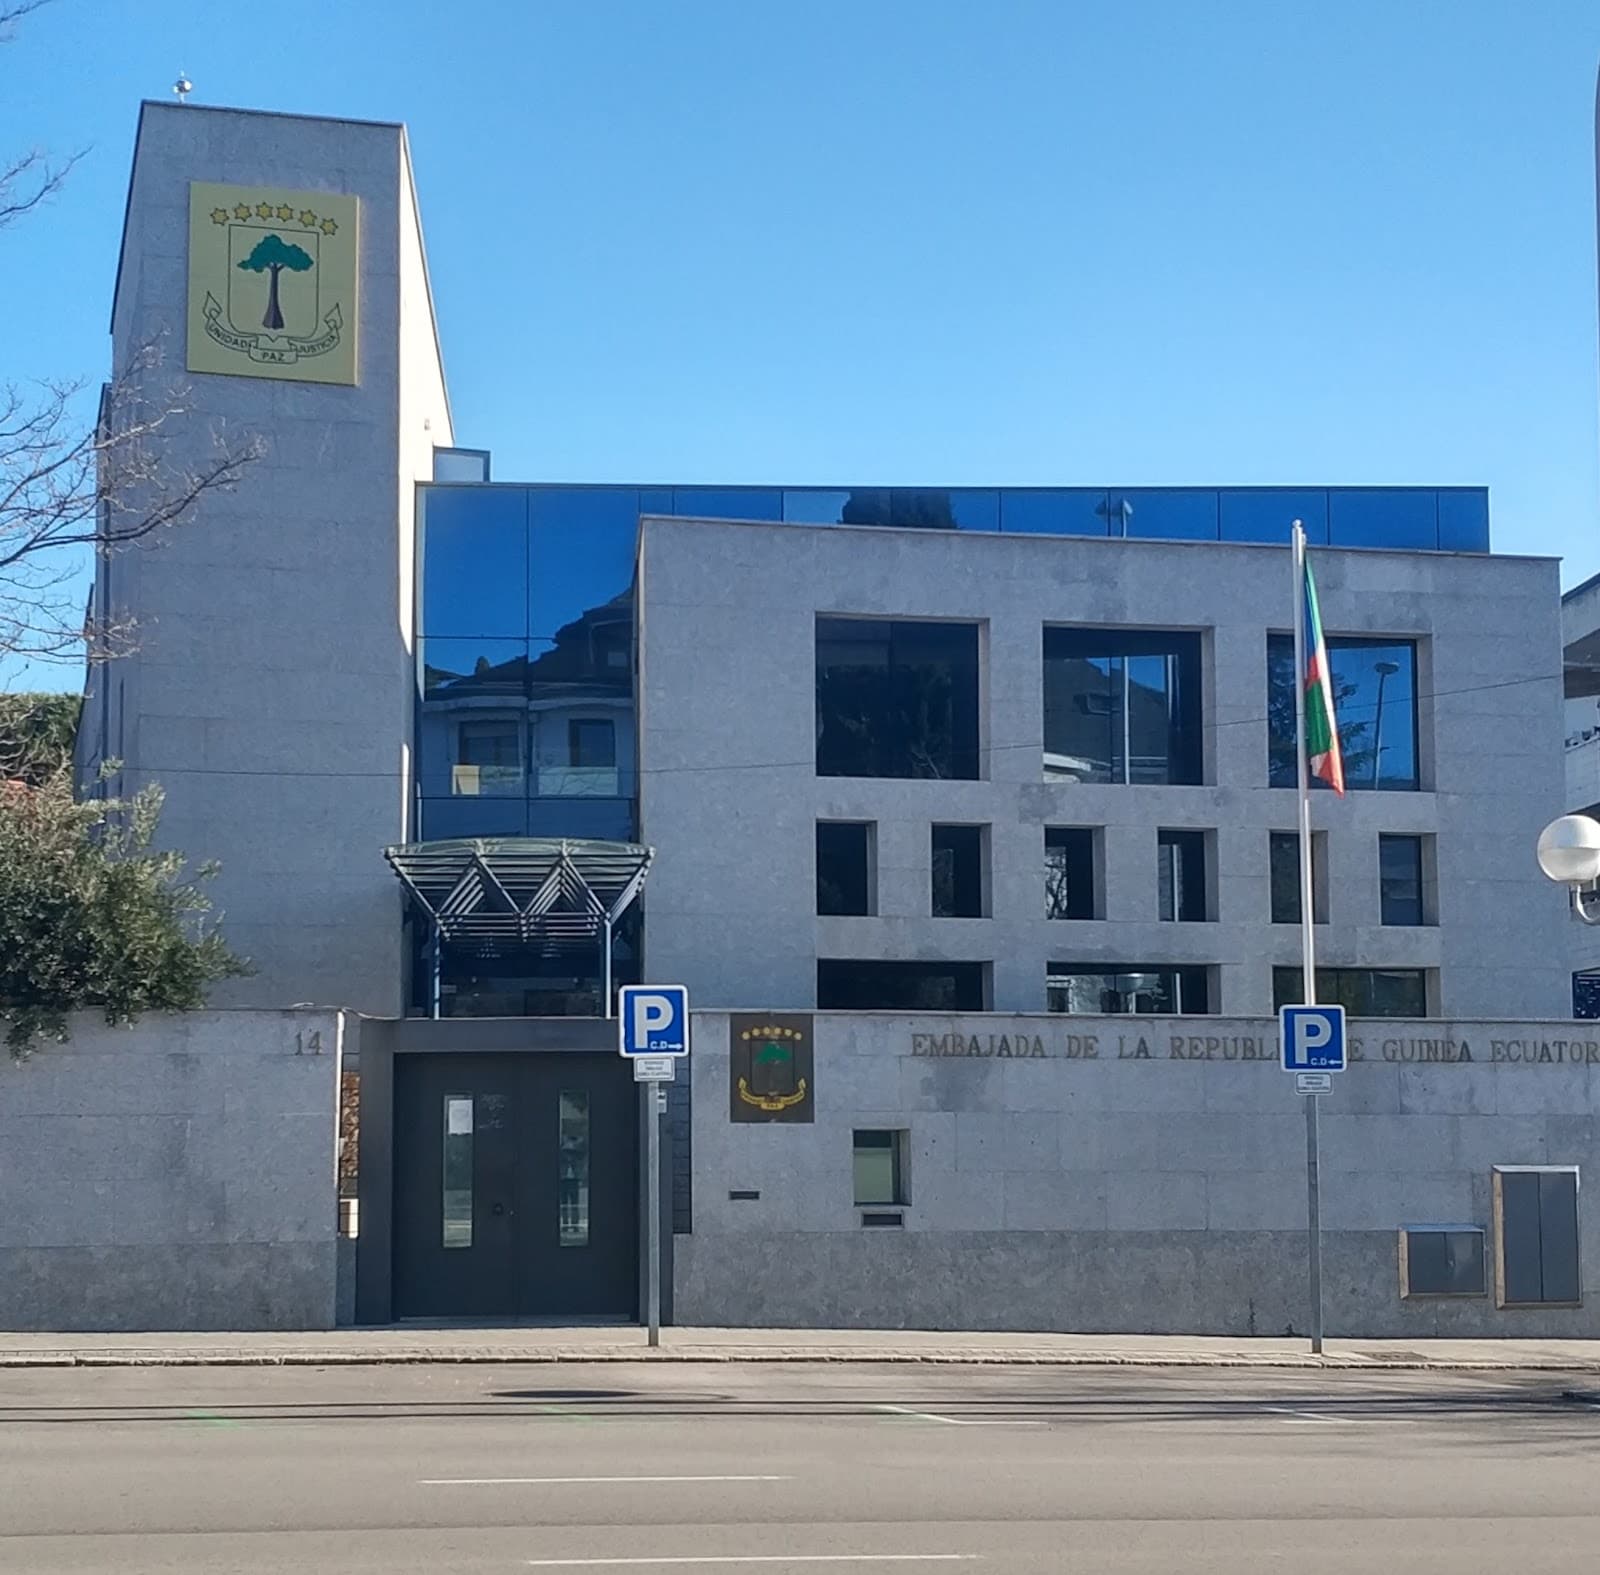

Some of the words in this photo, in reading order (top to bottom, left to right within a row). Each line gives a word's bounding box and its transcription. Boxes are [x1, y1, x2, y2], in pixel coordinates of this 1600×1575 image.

[208, 323, 248, 349] UNIDAD
[262, 351, 285, 361] PAZ
[634, 995, 674, 1049] P
[295, 1031, 322, 1056] 14
[910, 1033, 1046, 1058] EMBAJADA
[1066, 1034, 1098, 1059] DE
[1117, 1034, 1151, 1059] LA
[1168, 1036, 1281, 1060] REPUBLI
[1348, 1038, 1364, 1061] E
[1382, 1039, 1473, 1063] GUINEA
[1294, 1014, 1332, 1064] P
